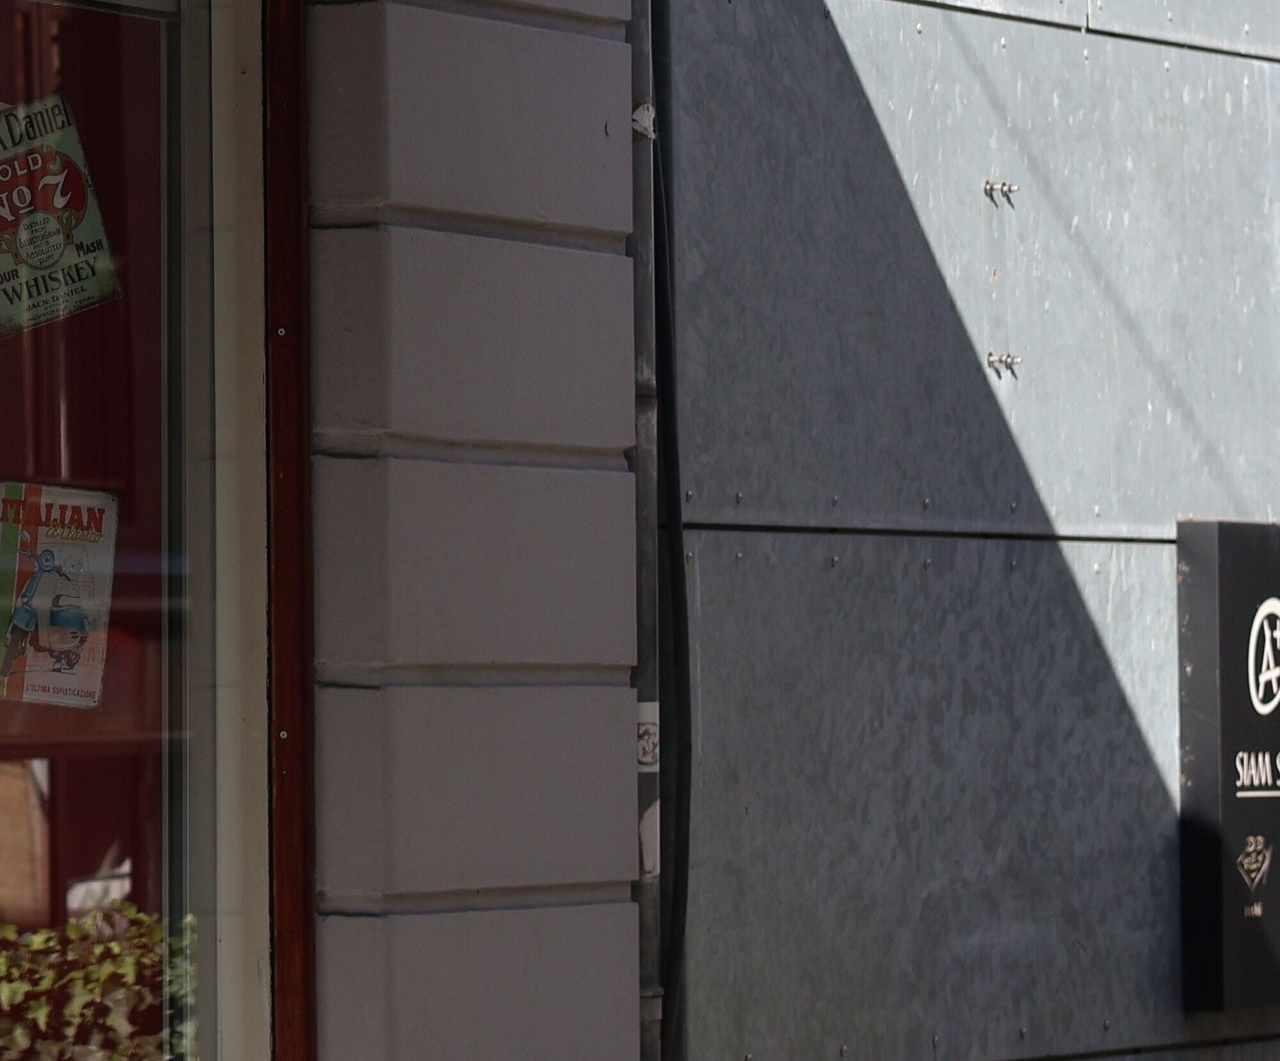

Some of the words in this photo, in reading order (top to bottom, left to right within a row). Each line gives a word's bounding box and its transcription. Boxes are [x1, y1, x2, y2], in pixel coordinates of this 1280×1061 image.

[4, 98, 73, 148] Daniel
[38, 169, 73, 209] 7
[75, 239, 105, 257] MASH
[0, 257, 97, 305] WHISKEY
[0, 498, 106, 533] ITALIAN
[1235, 750, 1273, 788] SIAM
